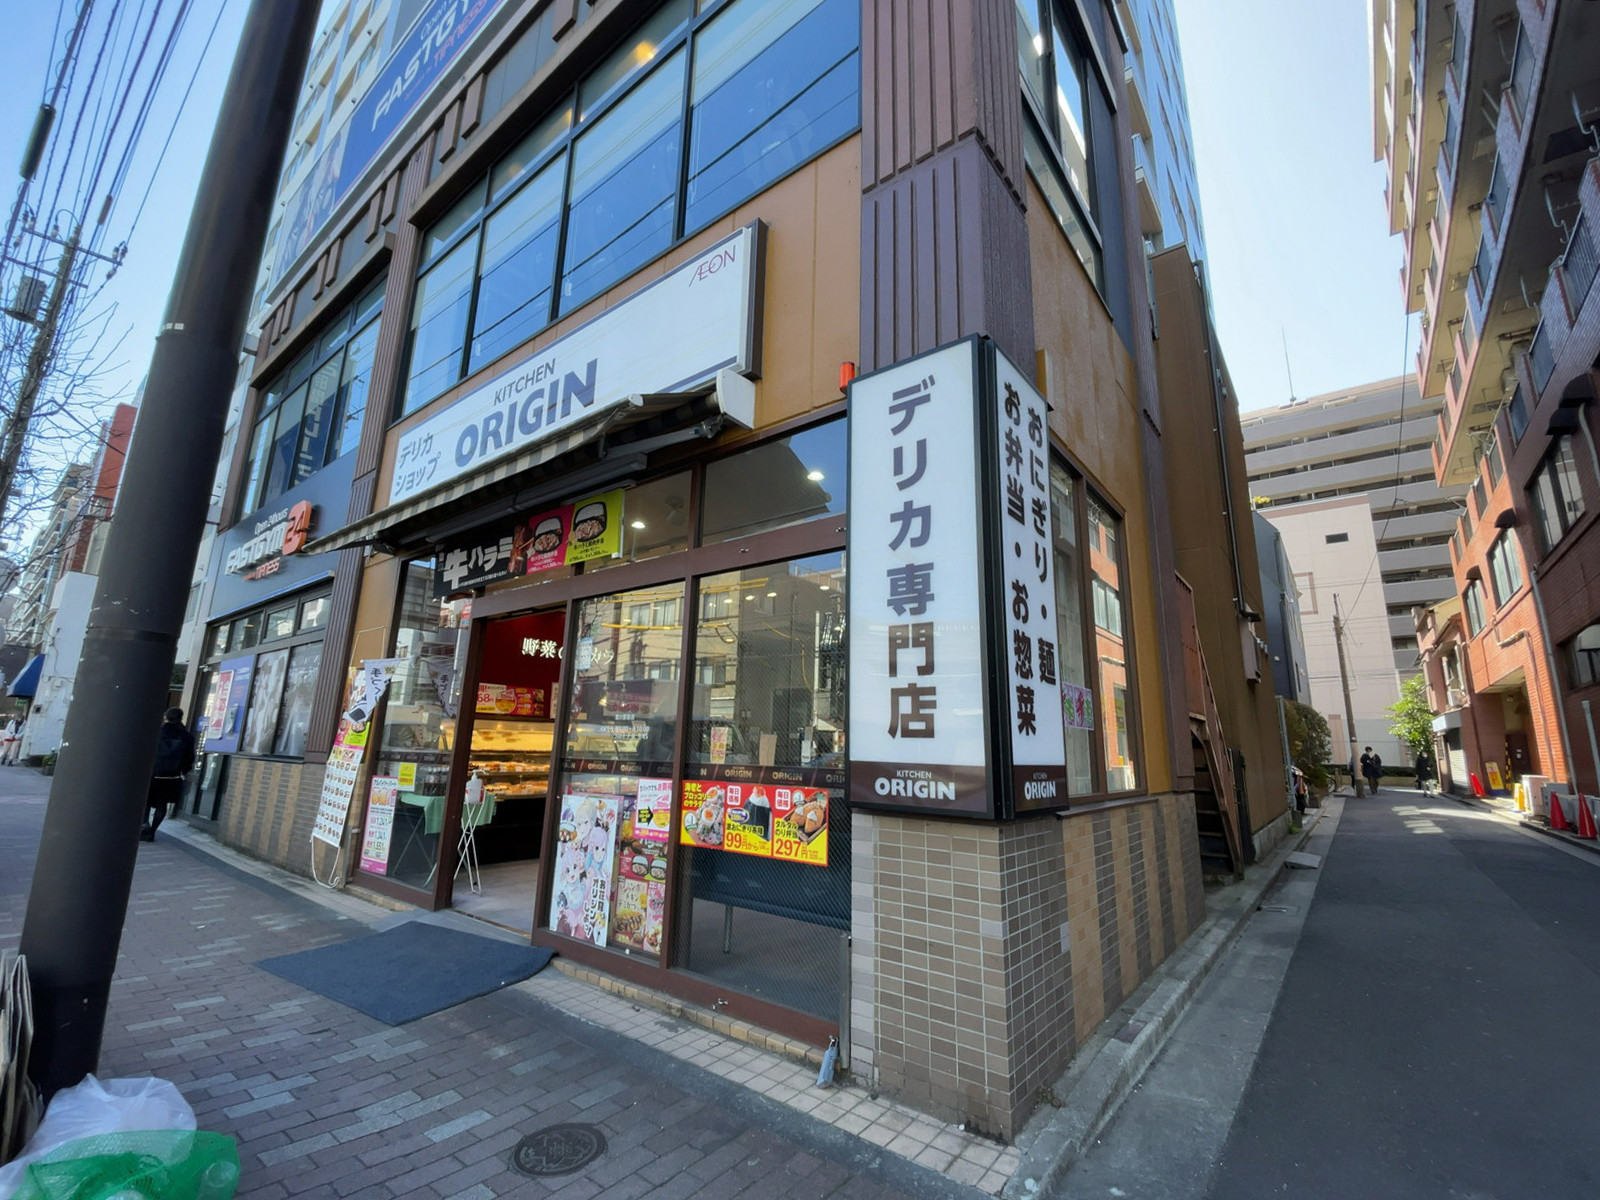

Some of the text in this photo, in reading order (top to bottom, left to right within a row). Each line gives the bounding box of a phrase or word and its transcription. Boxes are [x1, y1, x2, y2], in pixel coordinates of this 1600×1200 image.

[493, 358, 556, 407] KITCHEN
[455, 358, 599, 468] ORIGIN
[399, 432, 434, 470] デリカ
[395, 452, 442, 497] ショップ
[443, 536, 513, 590] 牛ハラミ
[886, 374, 938, 739] デリカ専門店
[1004, 381, 1037, 737] お弁当・お惣菜
[1027, 407, 1057, 685] おにぎり・麺
[725, 769, 752, 778] ORIGIN
[772, 772, 803, 781] ORIGIN
[874, 776, 955, 801] ORIGIN
[896, 769, 932, 779] KITCHEN
[1024, 780, 1056, 801] ORIGIN
